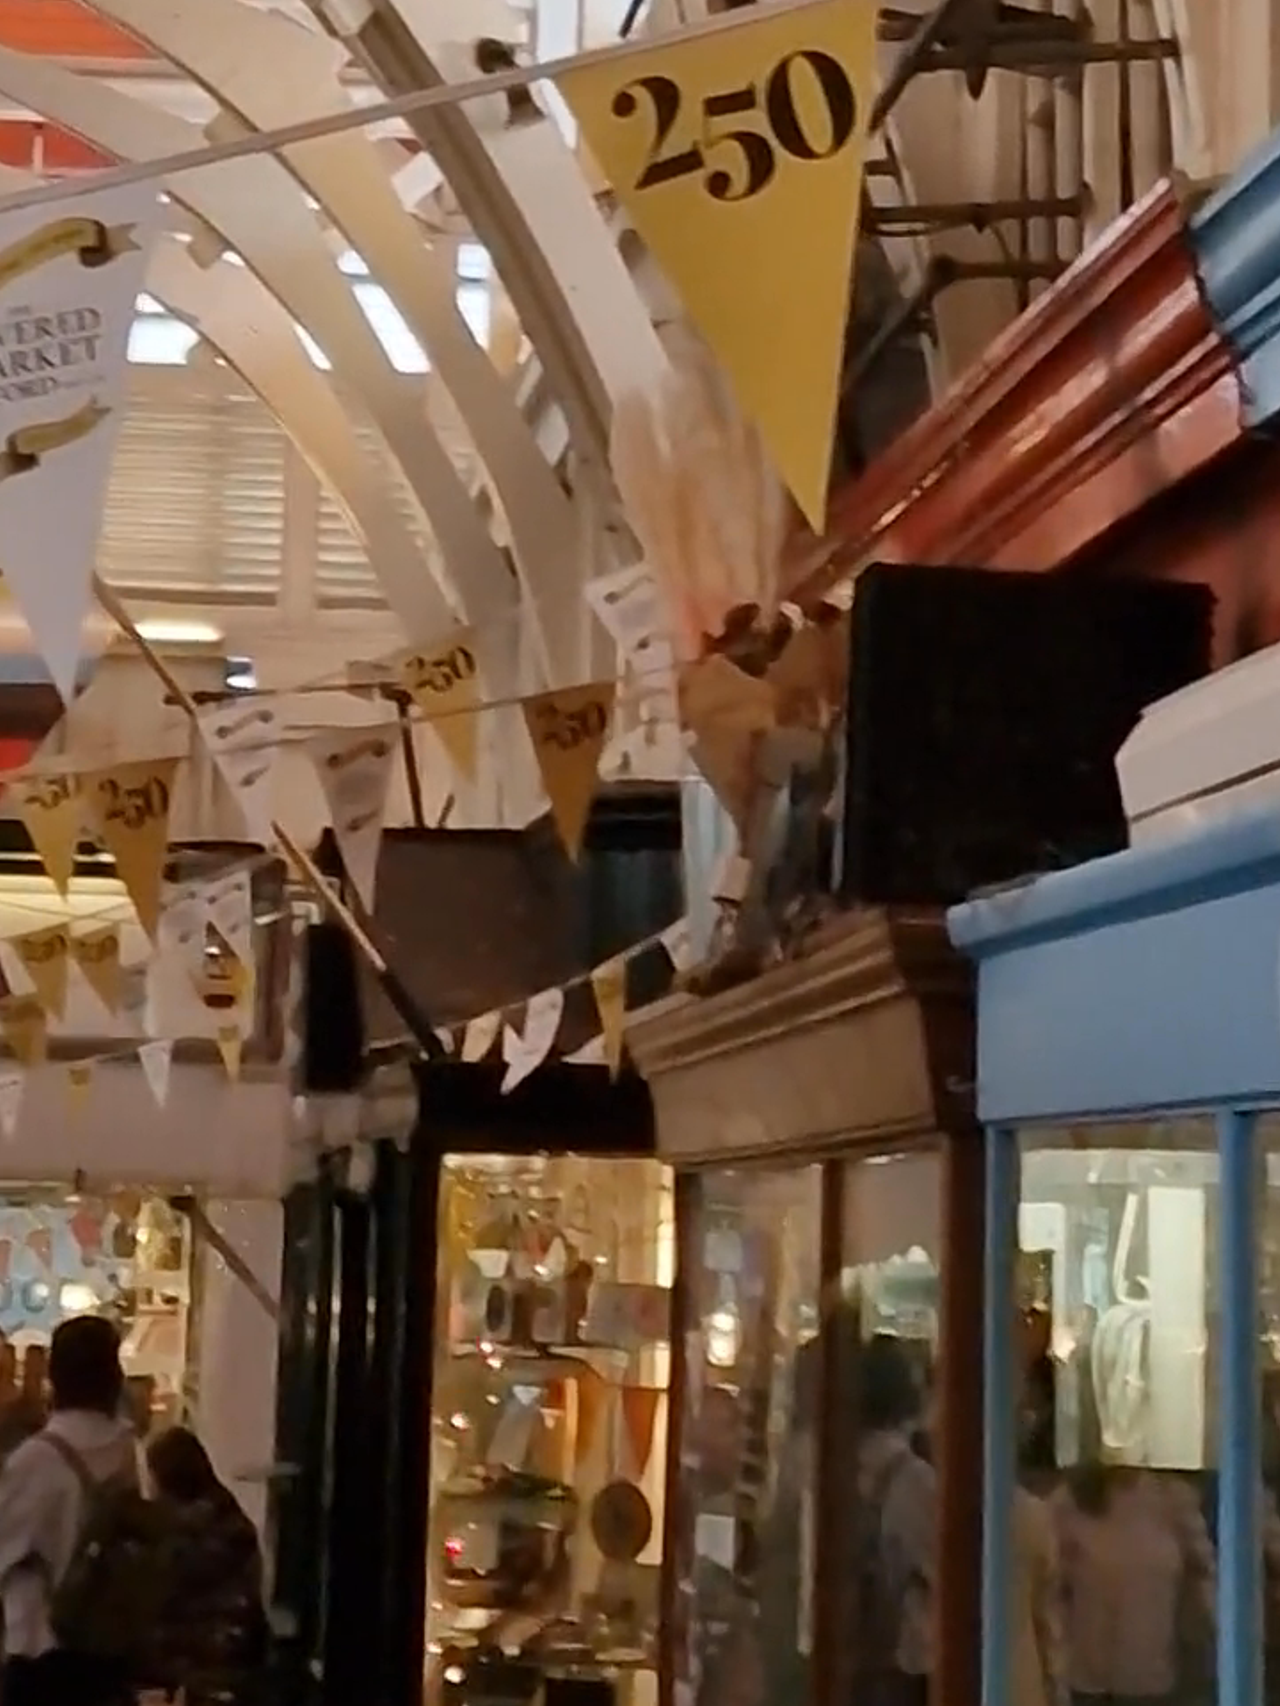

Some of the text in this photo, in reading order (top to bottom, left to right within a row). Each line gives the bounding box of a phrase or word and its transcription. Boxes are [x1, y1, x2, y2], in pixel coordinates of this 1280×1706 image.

[610, 49, 858, 202] 250
[405, 645, 476, 693] 250
[535, 700, 608, 751] 250
[97, 774, 169, 829] 250
